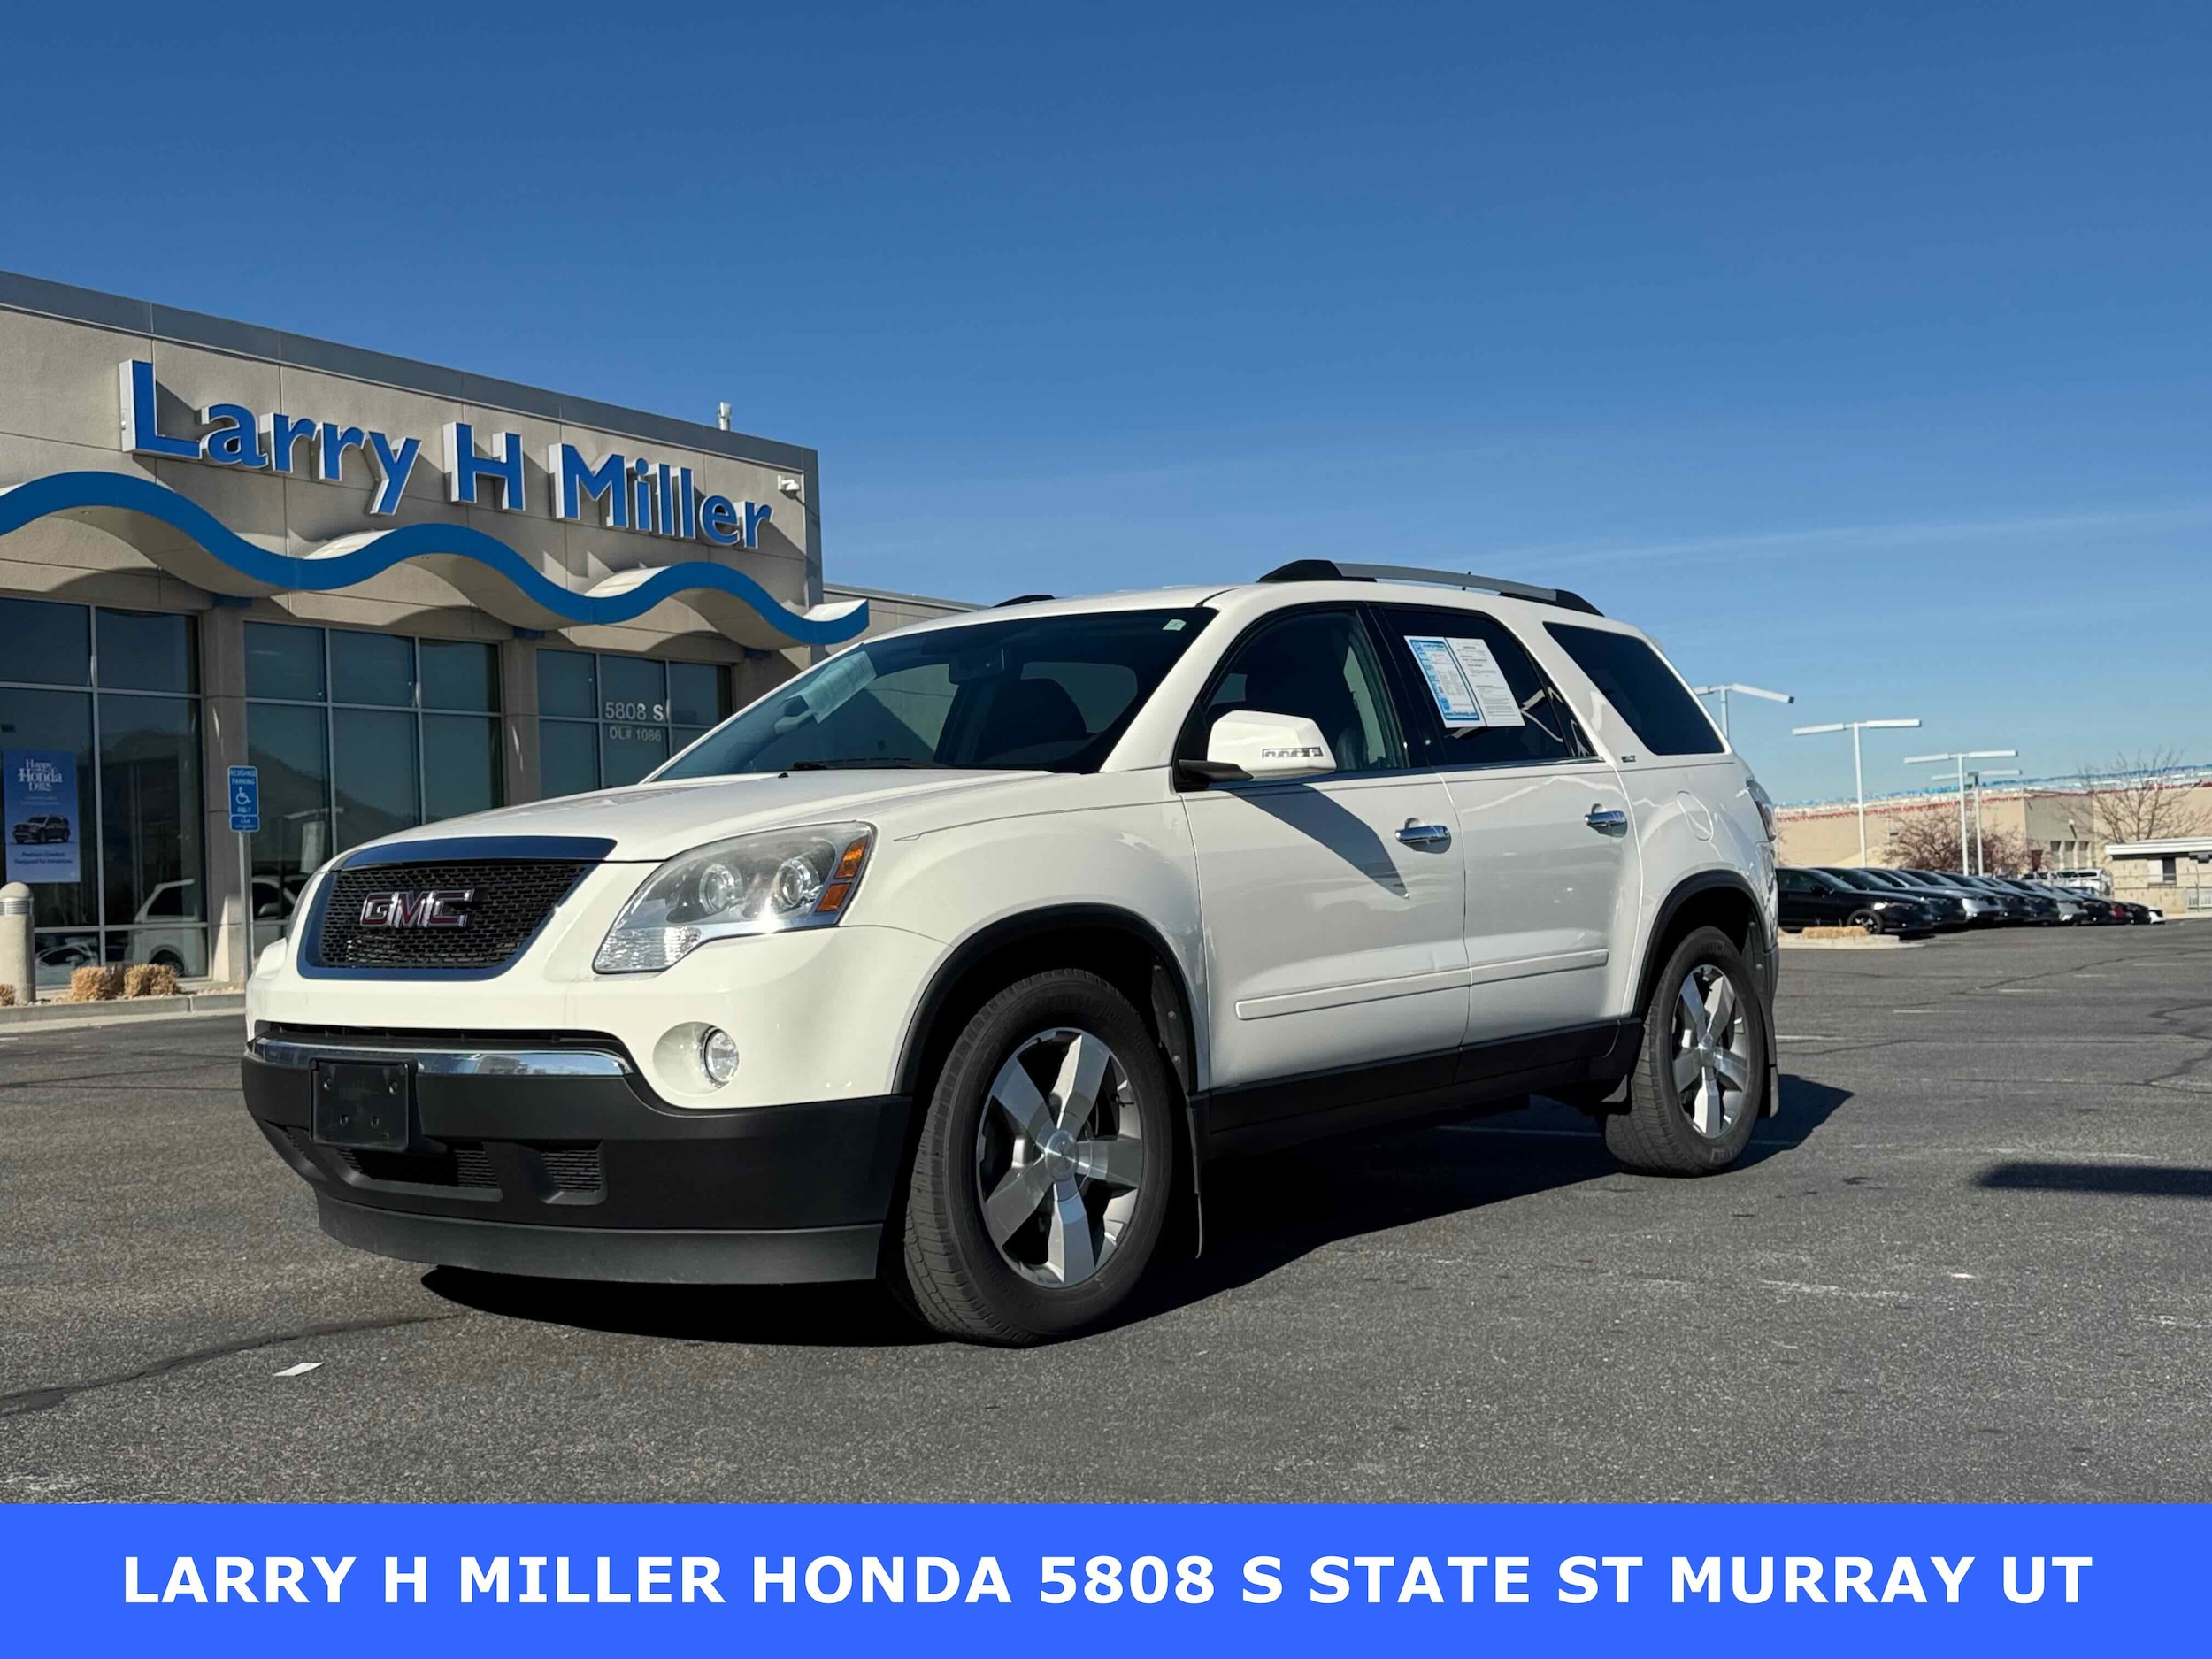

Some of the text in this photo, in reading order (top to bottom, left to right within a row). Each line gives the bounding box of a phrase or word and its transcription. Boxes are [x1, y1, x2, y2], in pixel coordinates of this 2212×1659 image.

[119, 359, 773, 549] Larry H Miller
[605, 702, 664, 721] 5808 S
[18, 768, 63, 783] Honda
[360, 889, 475, 928] GMC
